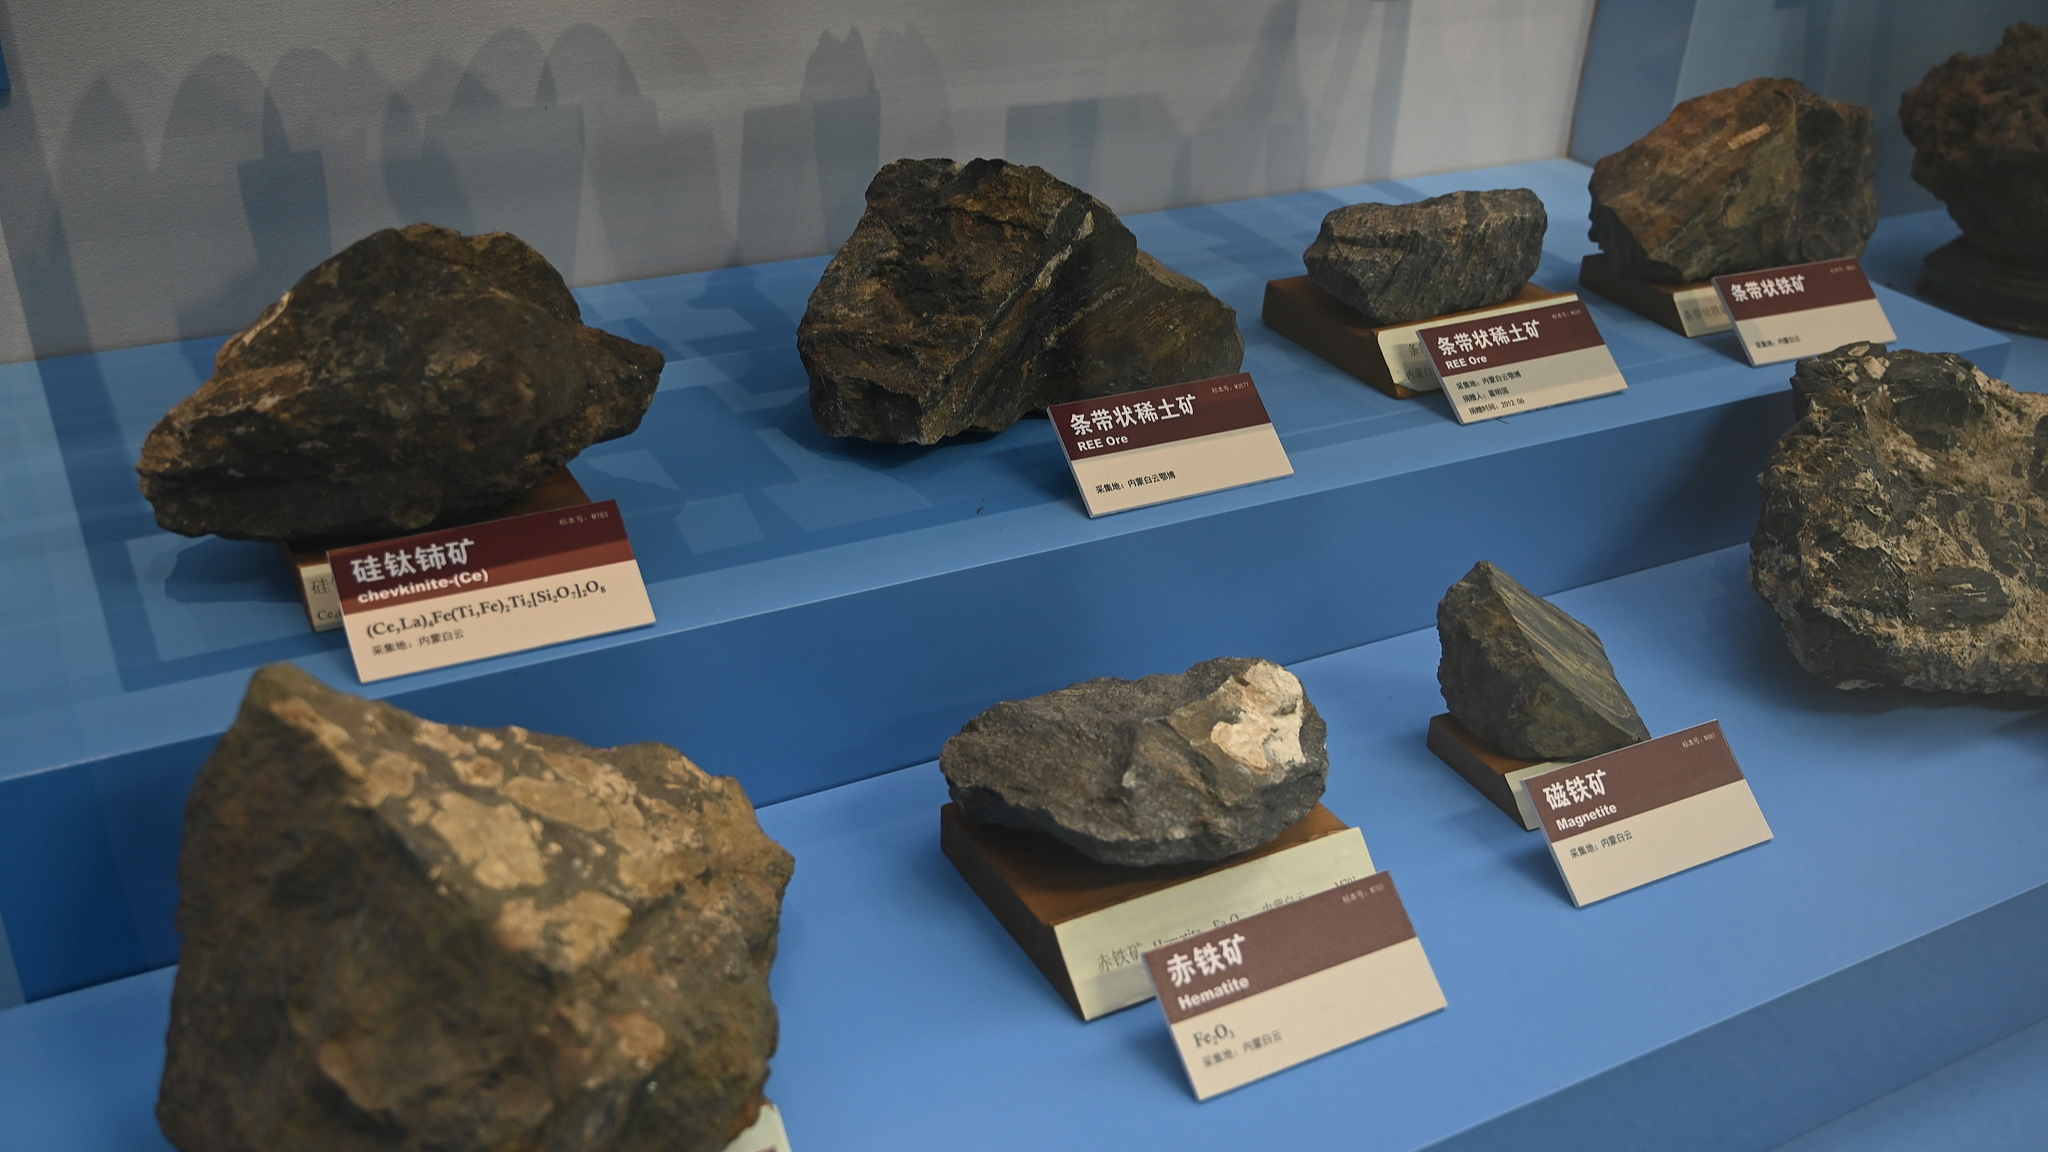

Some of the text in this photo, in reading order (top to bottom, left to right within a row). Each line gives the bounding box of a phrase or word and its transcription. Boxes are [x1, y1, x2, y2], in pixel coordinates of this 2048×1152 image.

[1730, 274, 1805, 303] 条带状铁矿
[1437, 319, 1540, 357] 条带状稀土矿
[1445, 354, 1488, 370] REE Ore
[1069, 393, 1197, 437] 条带状稀土矿
[1077, 434, 1129, 452] REE Ore
[350, 538, 476, 584] 硅钛铈矿
[357, 568, 489, 604] chevkinite-(Ce)
[1542, 769, 1607, 811] 磁铁矿
[1555, 803, 1618, 831] Magnetite
[1166, 932, 1246, 987] 赤铁矿
[1178, 975, 1250, 1011] Hematite
